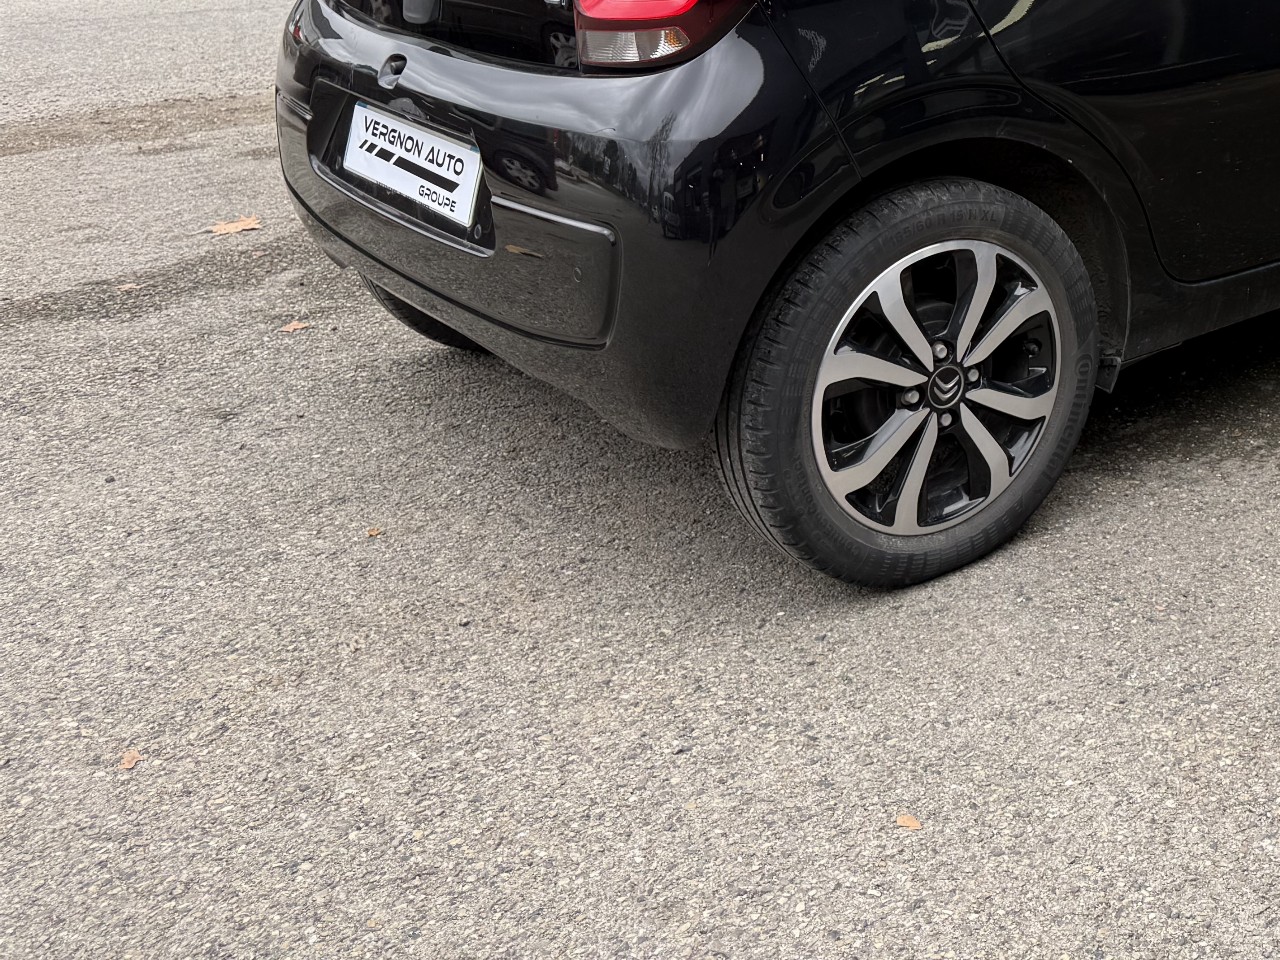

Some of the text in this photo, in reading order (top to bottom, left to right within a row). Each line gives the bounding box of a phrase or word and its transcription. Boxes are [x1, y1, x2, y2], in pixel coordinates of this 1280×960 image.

[364, 115, 465, 177] VERGNON AUTO
[418, 184, 457, 213] GROUPE
